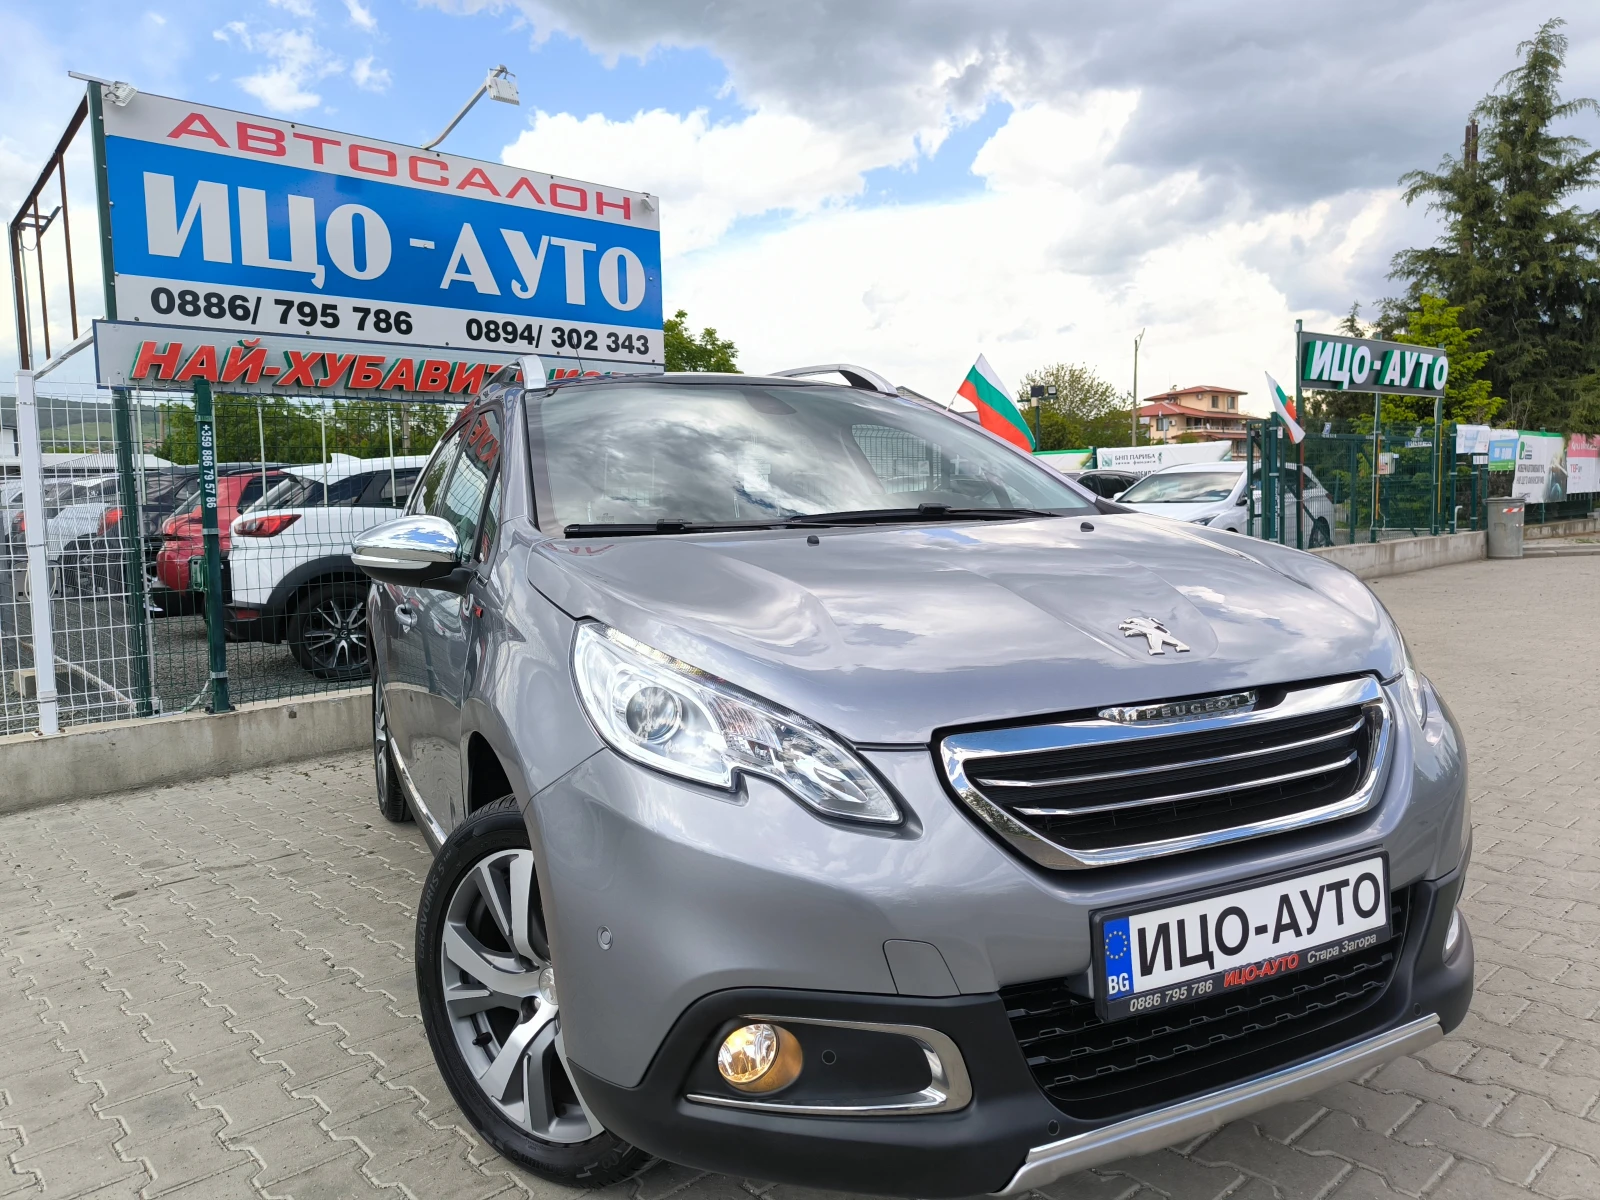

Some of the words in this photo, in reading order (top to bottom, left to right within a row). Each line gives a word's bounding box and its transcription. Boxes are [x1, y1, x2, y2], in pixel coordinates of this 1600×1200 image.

[167, 112, 632, 221] АВТОСАЛОН
[150, 286, 263, 326] 0886/
[274, 299, 340, 329] 795
[352, 306, 413, 336] 786
[465, 317, 543, 350] 0894/
[551, 325, 599, 352] 302
[606, 331, 650, 357] 343
[1306, 340, 1449, 391] ИЦО-АУТО
[201, 424, 212, 447] +359
[202, 450, 213, 467] 886
[203, 469, 214, 481] 79
[205, 483, 215, 494] 57
[206, 497, 217, 508] 86
[1145, 696, 1241, 719] PEUGEOT
[1137, 872, 1381, 978] ИЦО-АУТО
[1107, 972, 1130, 996] BG
[1129, 994, 1161, 1012] 0886
[1165, 986, 1188, 1004] 795
[1191, 980, 1213, 998] 786
[1223, 953, 1299, 988] ИЦО-АУТО
[1307, 944, 1339, 964] Стара
[1342, 933, 1377, 953] Загора
